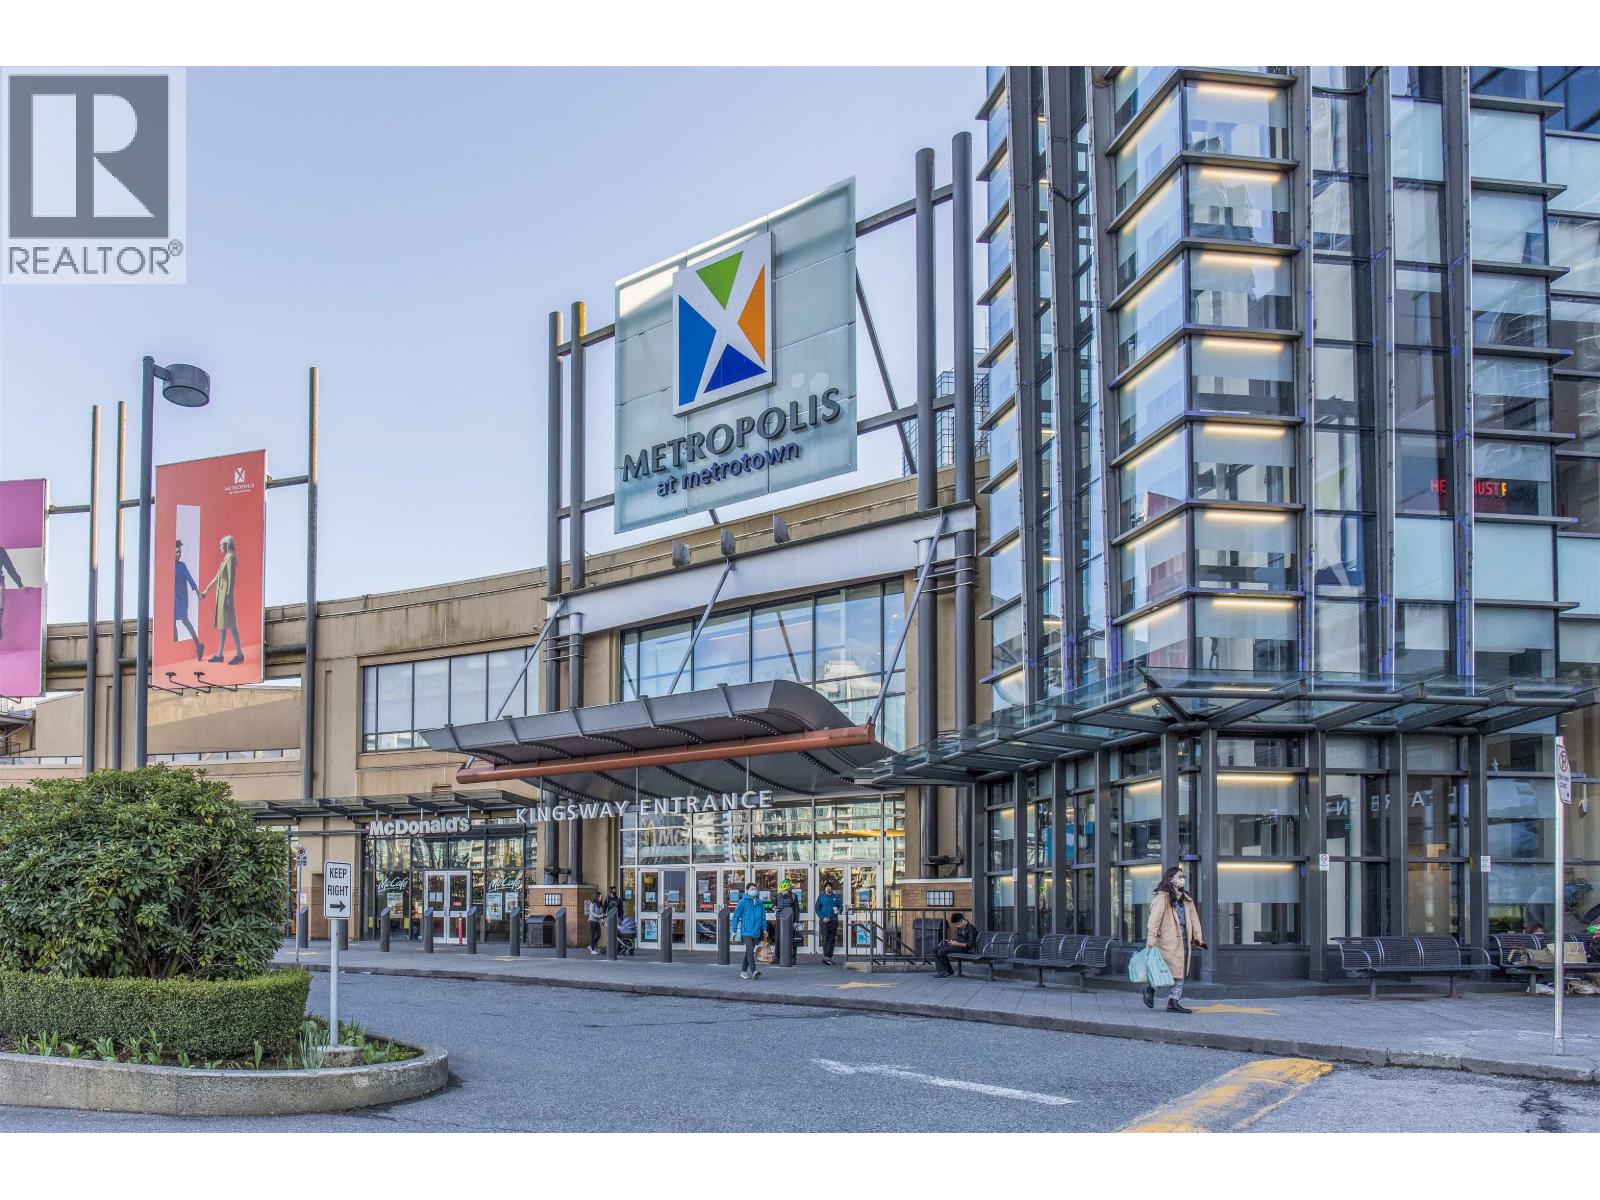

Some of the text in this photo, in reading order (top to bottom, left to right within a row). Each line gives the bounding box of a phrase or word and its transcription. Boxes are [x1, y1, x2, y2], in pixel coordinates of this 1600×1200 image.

[622, 387, 841, 482] METROPOLIS
[656, 442, 800, 497] at metrotown
[516, 790, 773, 823] KINGSWAY ENTRANCE
[369, 816, 471, 836] McDonald's
[329, 867, 348, 879] KEEP
[327, 884, 349, 896] RIGHT
